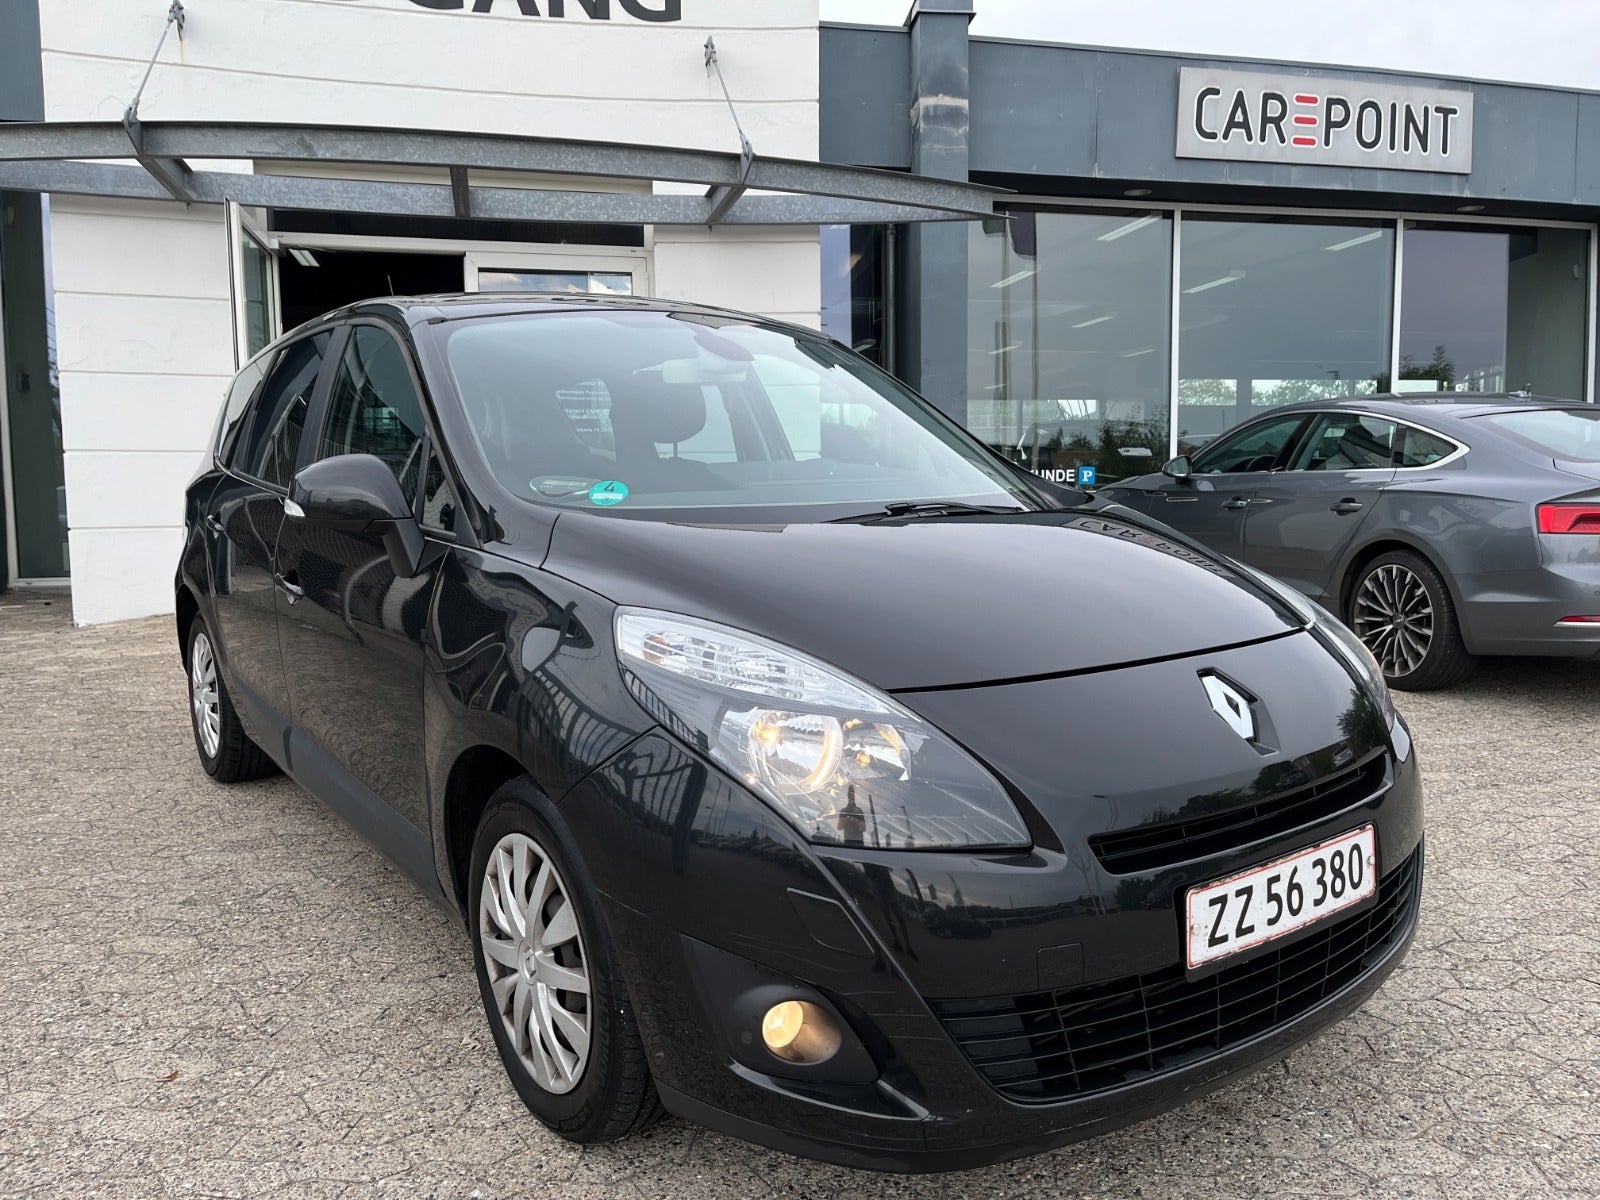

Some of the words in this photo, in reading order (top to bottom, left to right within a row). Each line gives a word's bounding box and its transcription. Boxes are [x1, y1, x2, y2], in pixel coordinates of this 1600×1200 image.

[1194, 86, 1459, 156] CAREPOINT
[603, 481, 616, 493] 4
[1030, 469, 1076, 482] UNDE
[1207, 884, 1255, 948] ZZ
[1266, 864, 1304, 927] 56
[1312, 843, 1364, 907] 380
